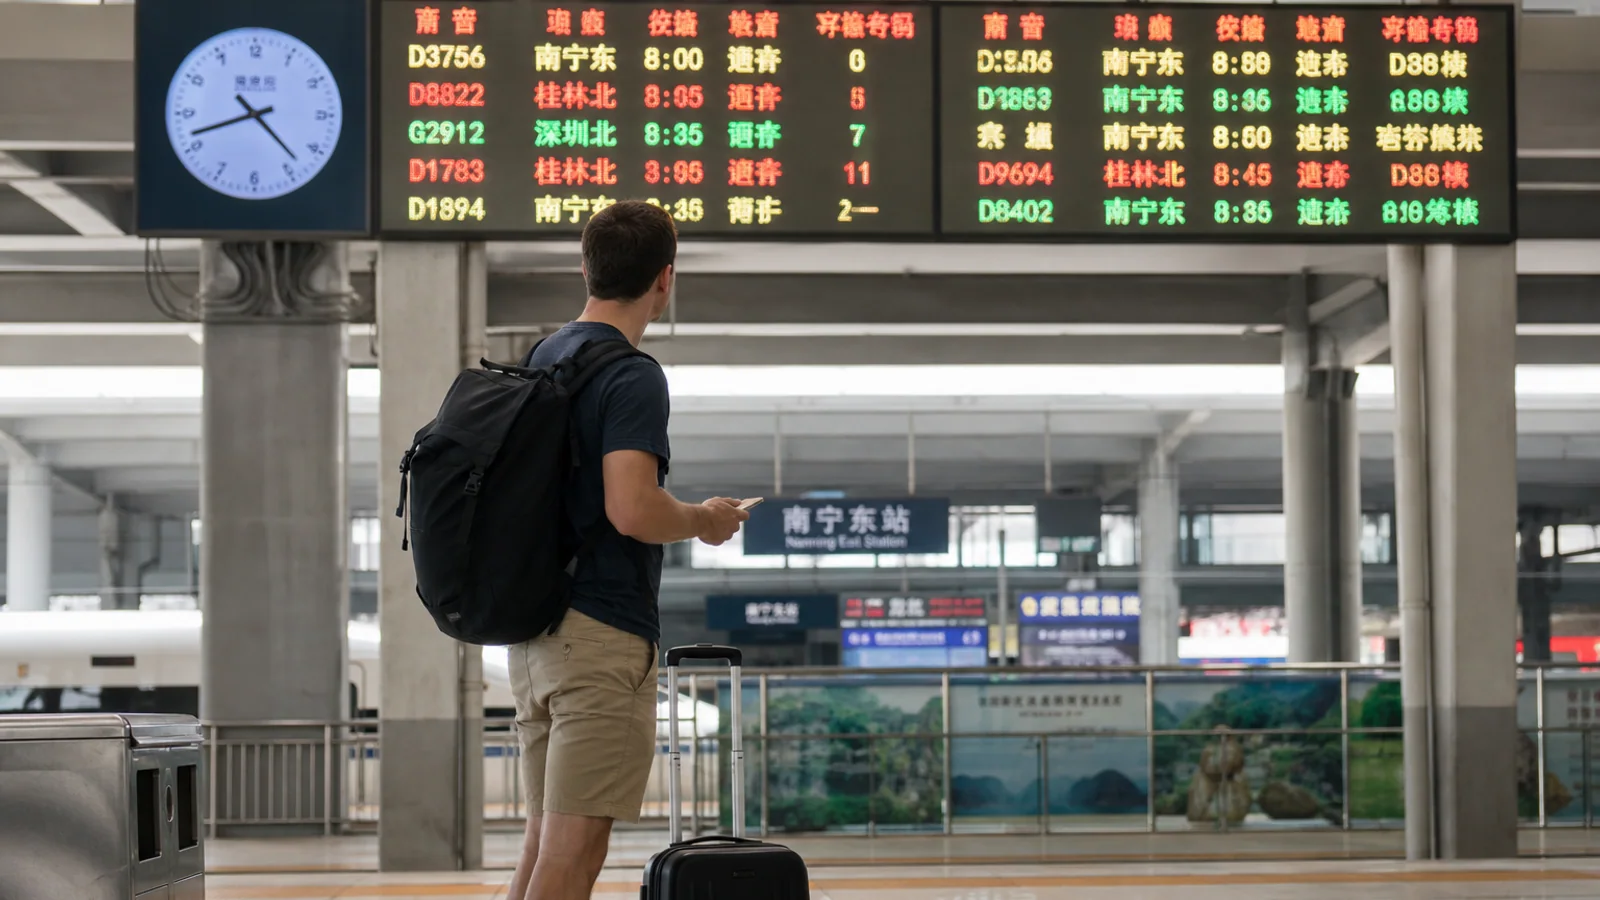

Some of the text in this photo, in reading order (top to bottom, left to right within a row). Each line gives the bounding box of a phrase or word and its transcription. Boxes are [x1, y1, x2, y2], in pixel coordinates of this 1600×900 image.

[249, 45, 262, 59] 12
[409, 44, 486, 69] D3756
[534, 43, 617, 73] 南宁东
[643, 46, 704, 71] 8:00
[1102, 47, 1184, 77] 南宁东
[409, 82, 485, 107] D8822
[534, 81, 617, 110] 桂林北
[643, 84, 704, 109] 8:05
[1102, 84, 1185, 114] 南宁东
[408, 120, 485, 144] G2912
[534, 119, 617, 148] 深圳北
[643, 121, 704, 147] 8:35
[849, 123, 866, 147] 7
[1102, 121, 1185, 151] 南宁东
[250, 171, 260, 185] 6
[409, 158, 485, 184] D1783
[534, 156, 617, 186] 桂林北
[843, 161, 870, 185] 11
[978, 161, 1054, 186] D9694
[1103, 159, 1186, 188] 桂林北
[409, 196, 486, 221] D1894
[978, 199, 1054, 223] D8402
[1103, 197, 1186, 226] 南宁东
[782, 504, 911, 535] 南宁东站
